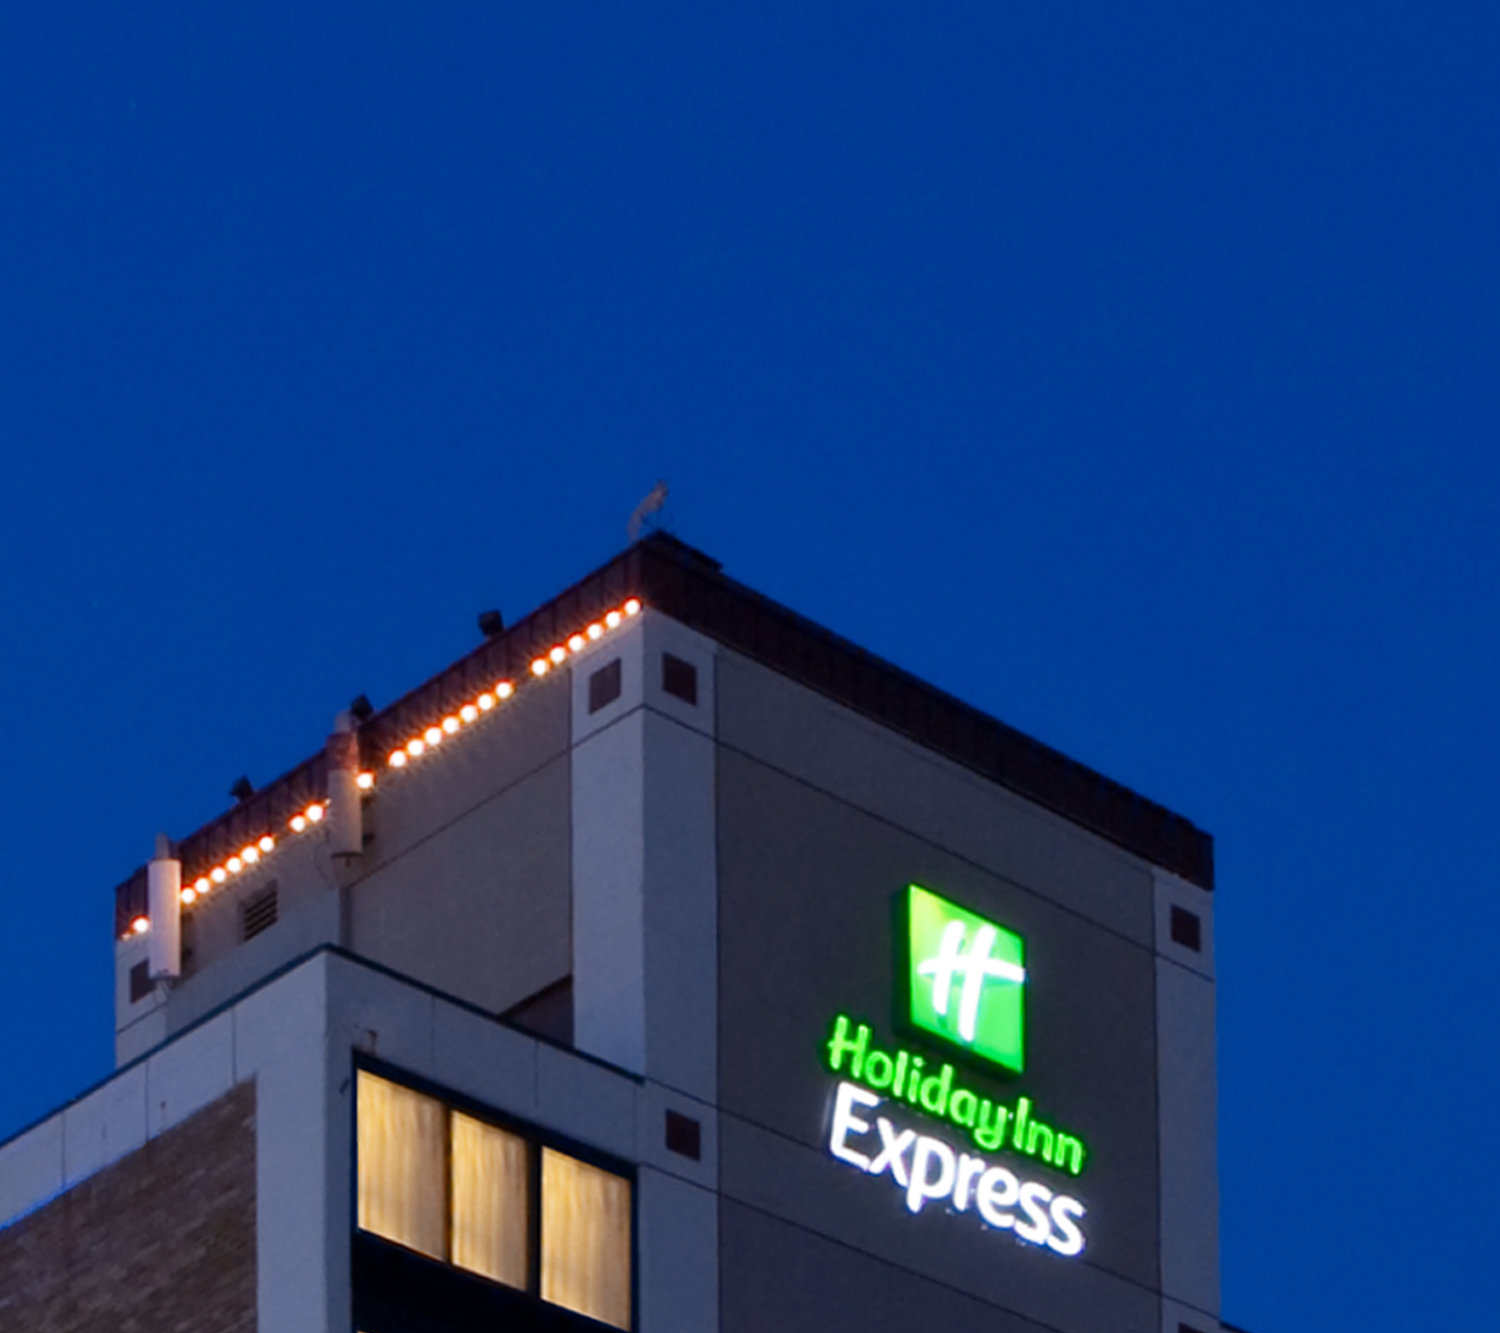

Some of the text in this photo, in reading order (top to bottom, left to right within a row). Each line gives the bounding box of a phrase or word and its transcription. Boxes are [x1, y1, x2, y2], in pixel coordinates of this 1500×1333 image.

[827, 1015, 1083, 1175] Holiday Inn
[830, 1081, 1086, 1255] Express
